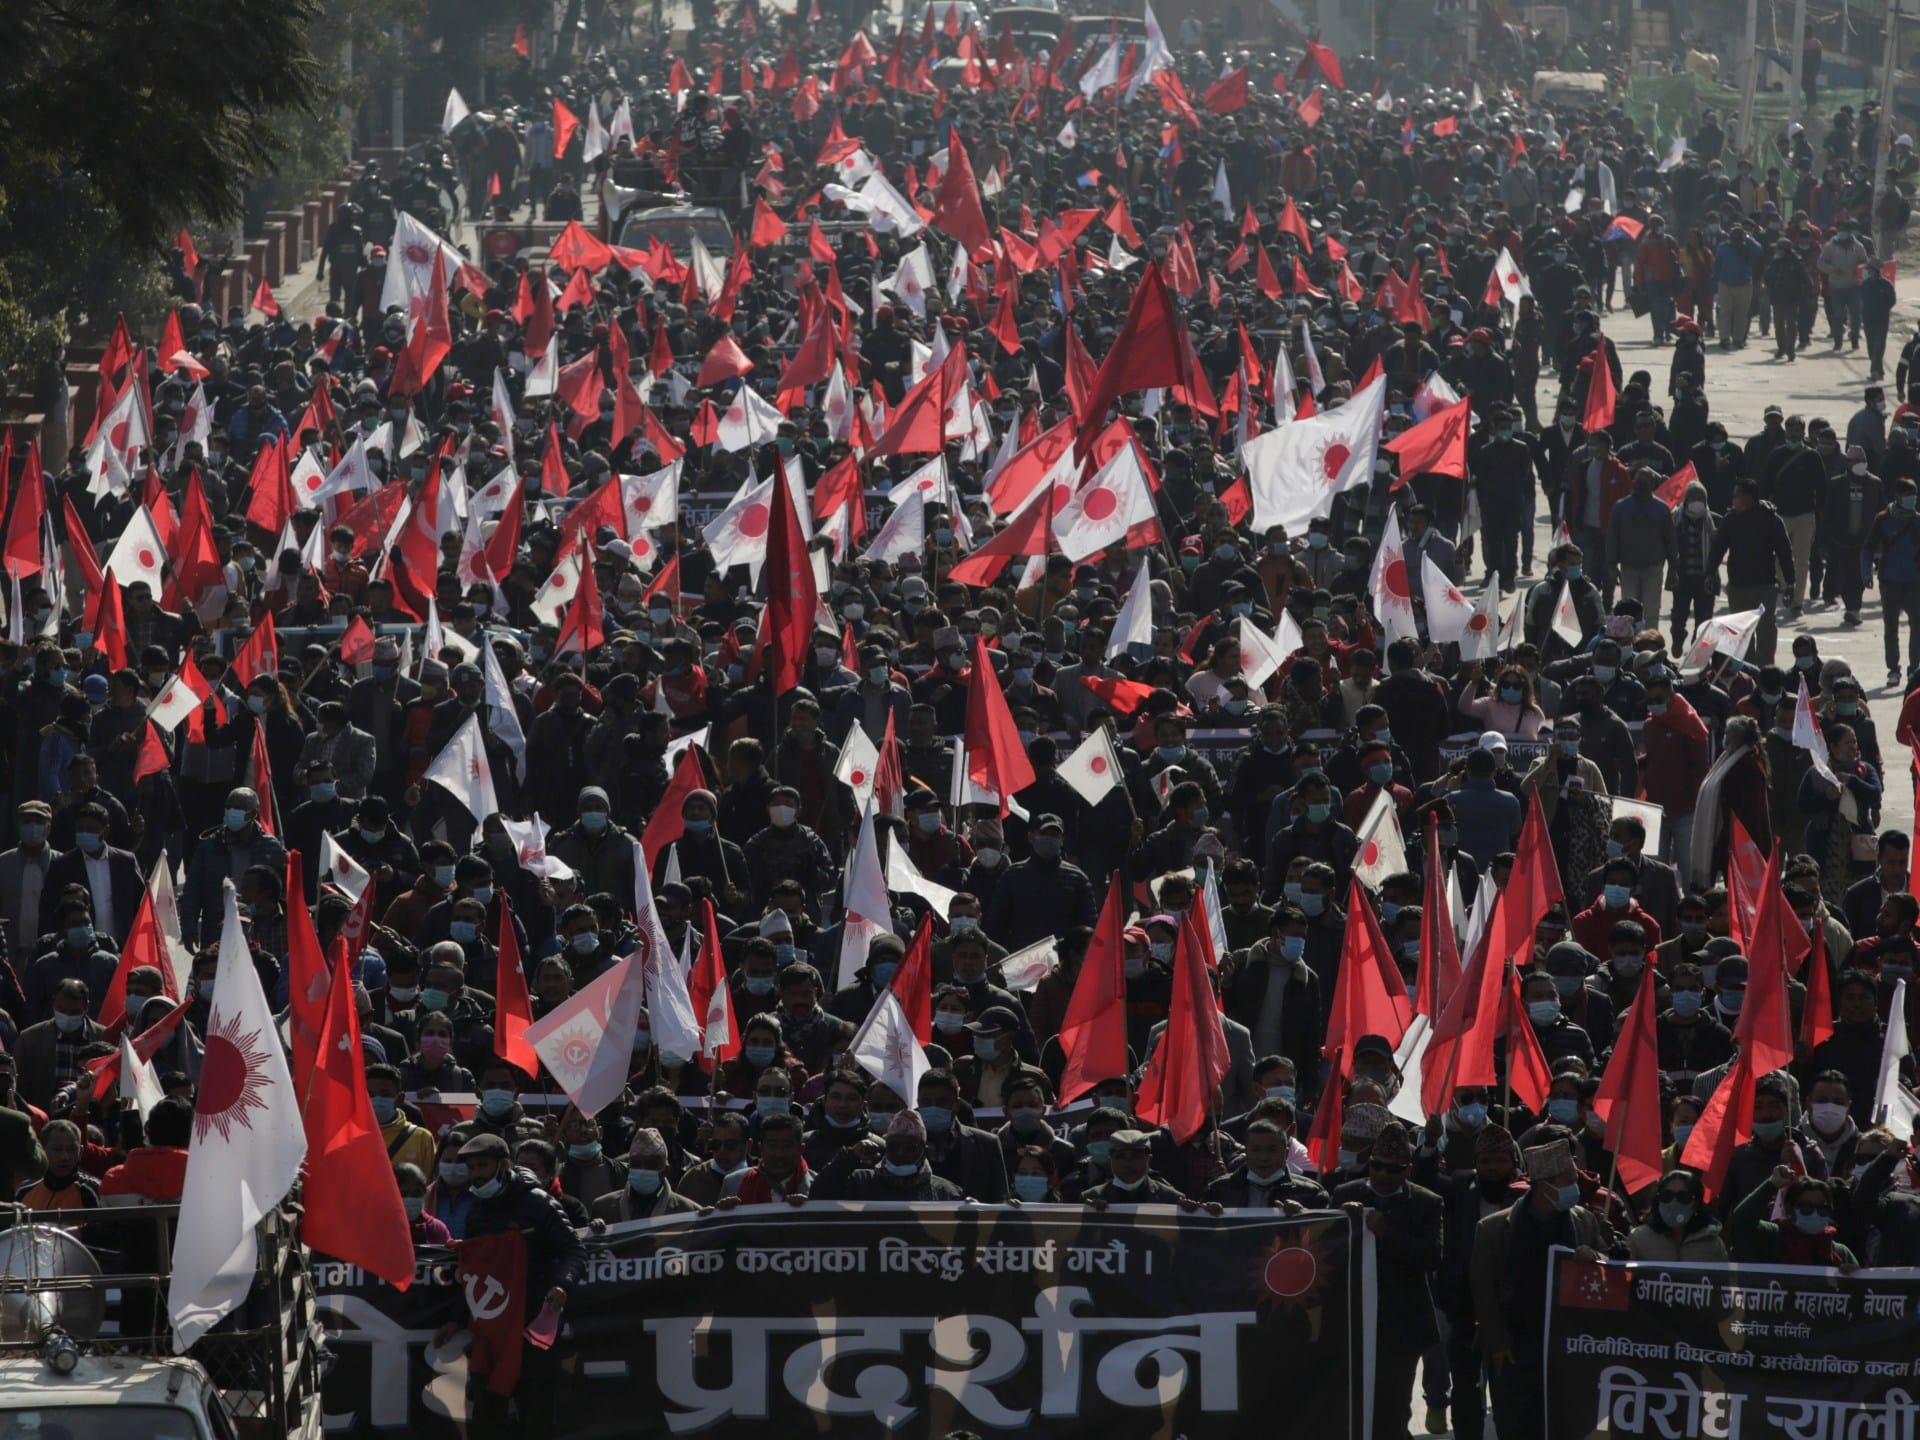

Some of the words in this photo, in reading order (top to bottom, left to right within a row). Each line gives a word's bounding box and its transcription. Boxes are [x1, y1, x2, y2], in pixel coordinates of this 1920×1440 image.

[736, 1247, 869, 1276] कदमका
[878, 1237, 966, 1282] विरुद्ध
[976, 1239, 1057, 1274] संघर्ष
[1636, 1272, 1713, 1309] आदिवासी
[1720, 1280, 1788, 1313] जनजाति
[1863, 1288, 1908, 1319] नेपाल
[1674, 1341, 1756, 1368] विघटनको
[1760, 1352, 1861, 1375] असंवैधानिक
[1864, 1359, 1910, 1376] कदम
[1597, 1365, 1748, 1440] विरोध
